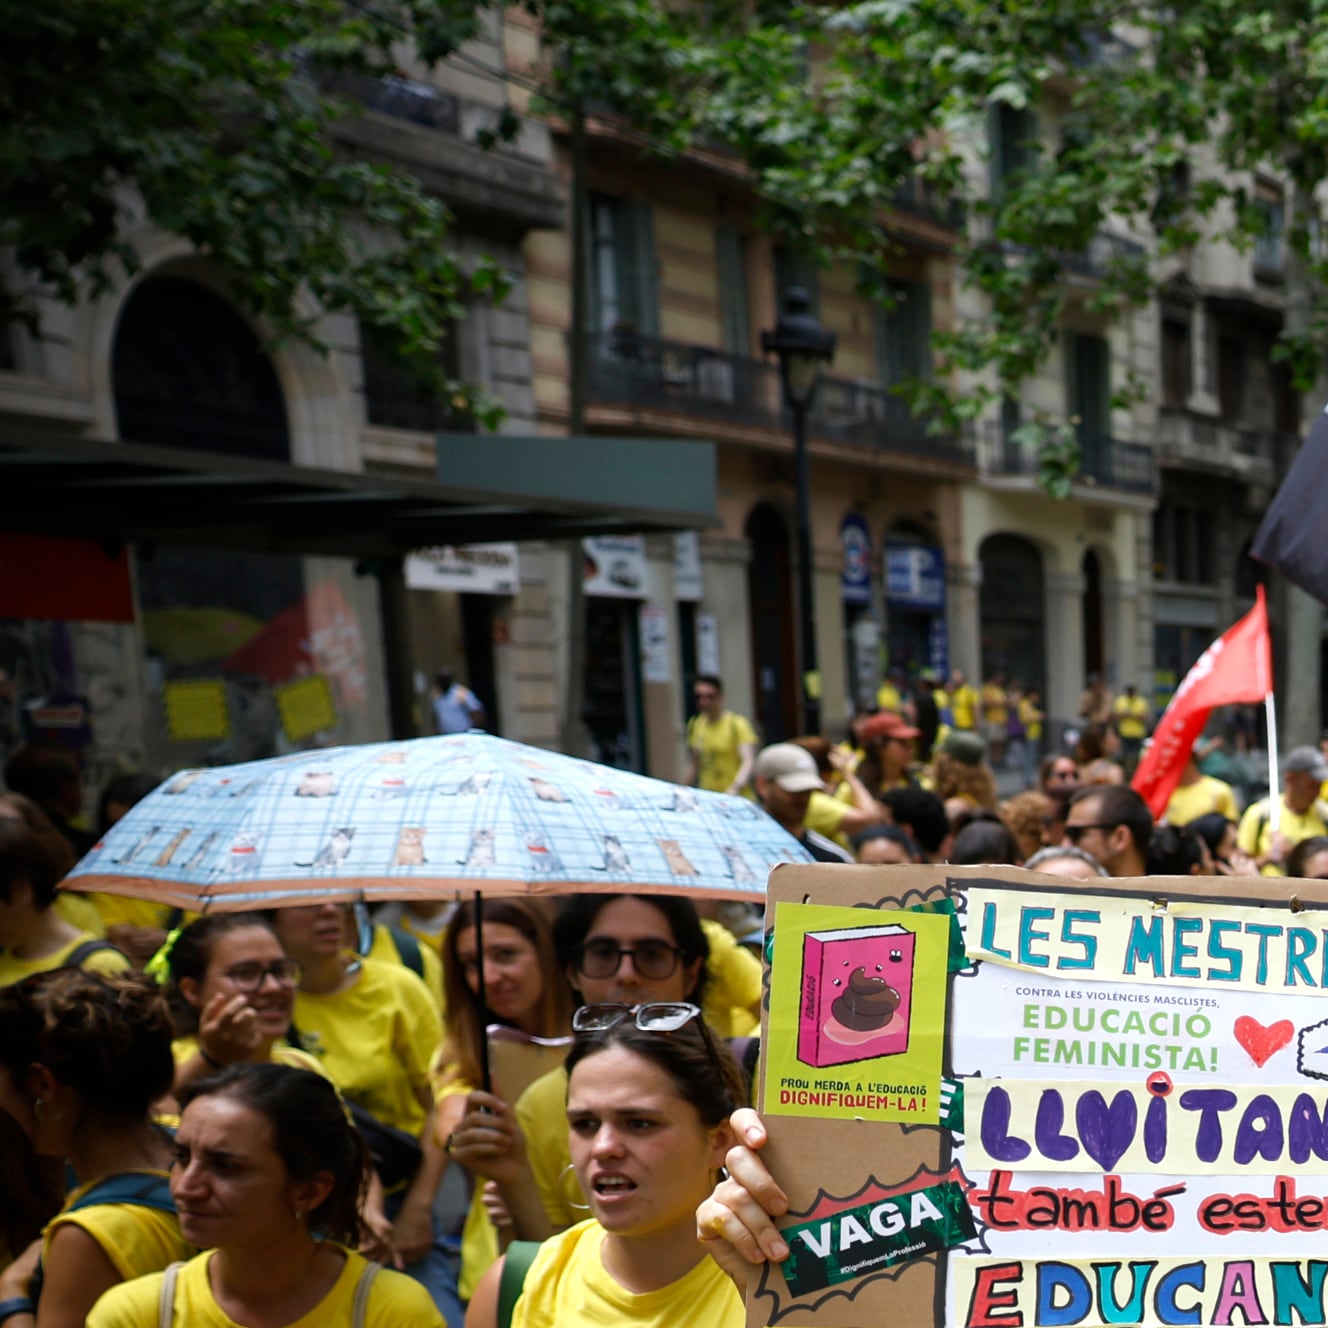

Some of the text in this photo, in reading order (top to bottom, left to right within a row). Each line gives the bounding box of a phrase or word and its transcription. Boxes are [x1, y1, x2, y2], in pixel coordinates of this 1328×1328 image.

[980, 902, 1101, 971] LES
[1015, 986, 1220, 1009] CONTRA LES VIOLÈNCIES MASCLISTES,
[1023, 1004, 1213, 1040] EDUCACIÓ
[1012, 1036, 1219, 1073] FEMINISTA!
[781, 1078, 810, 1090] PROU
[814, 1080, 851, 1092] MERDA
[855, 1082, 866, 1093] A
[970, 1169, 1187, 1232] també
[798, 1192, 944, 1258] VAGA
